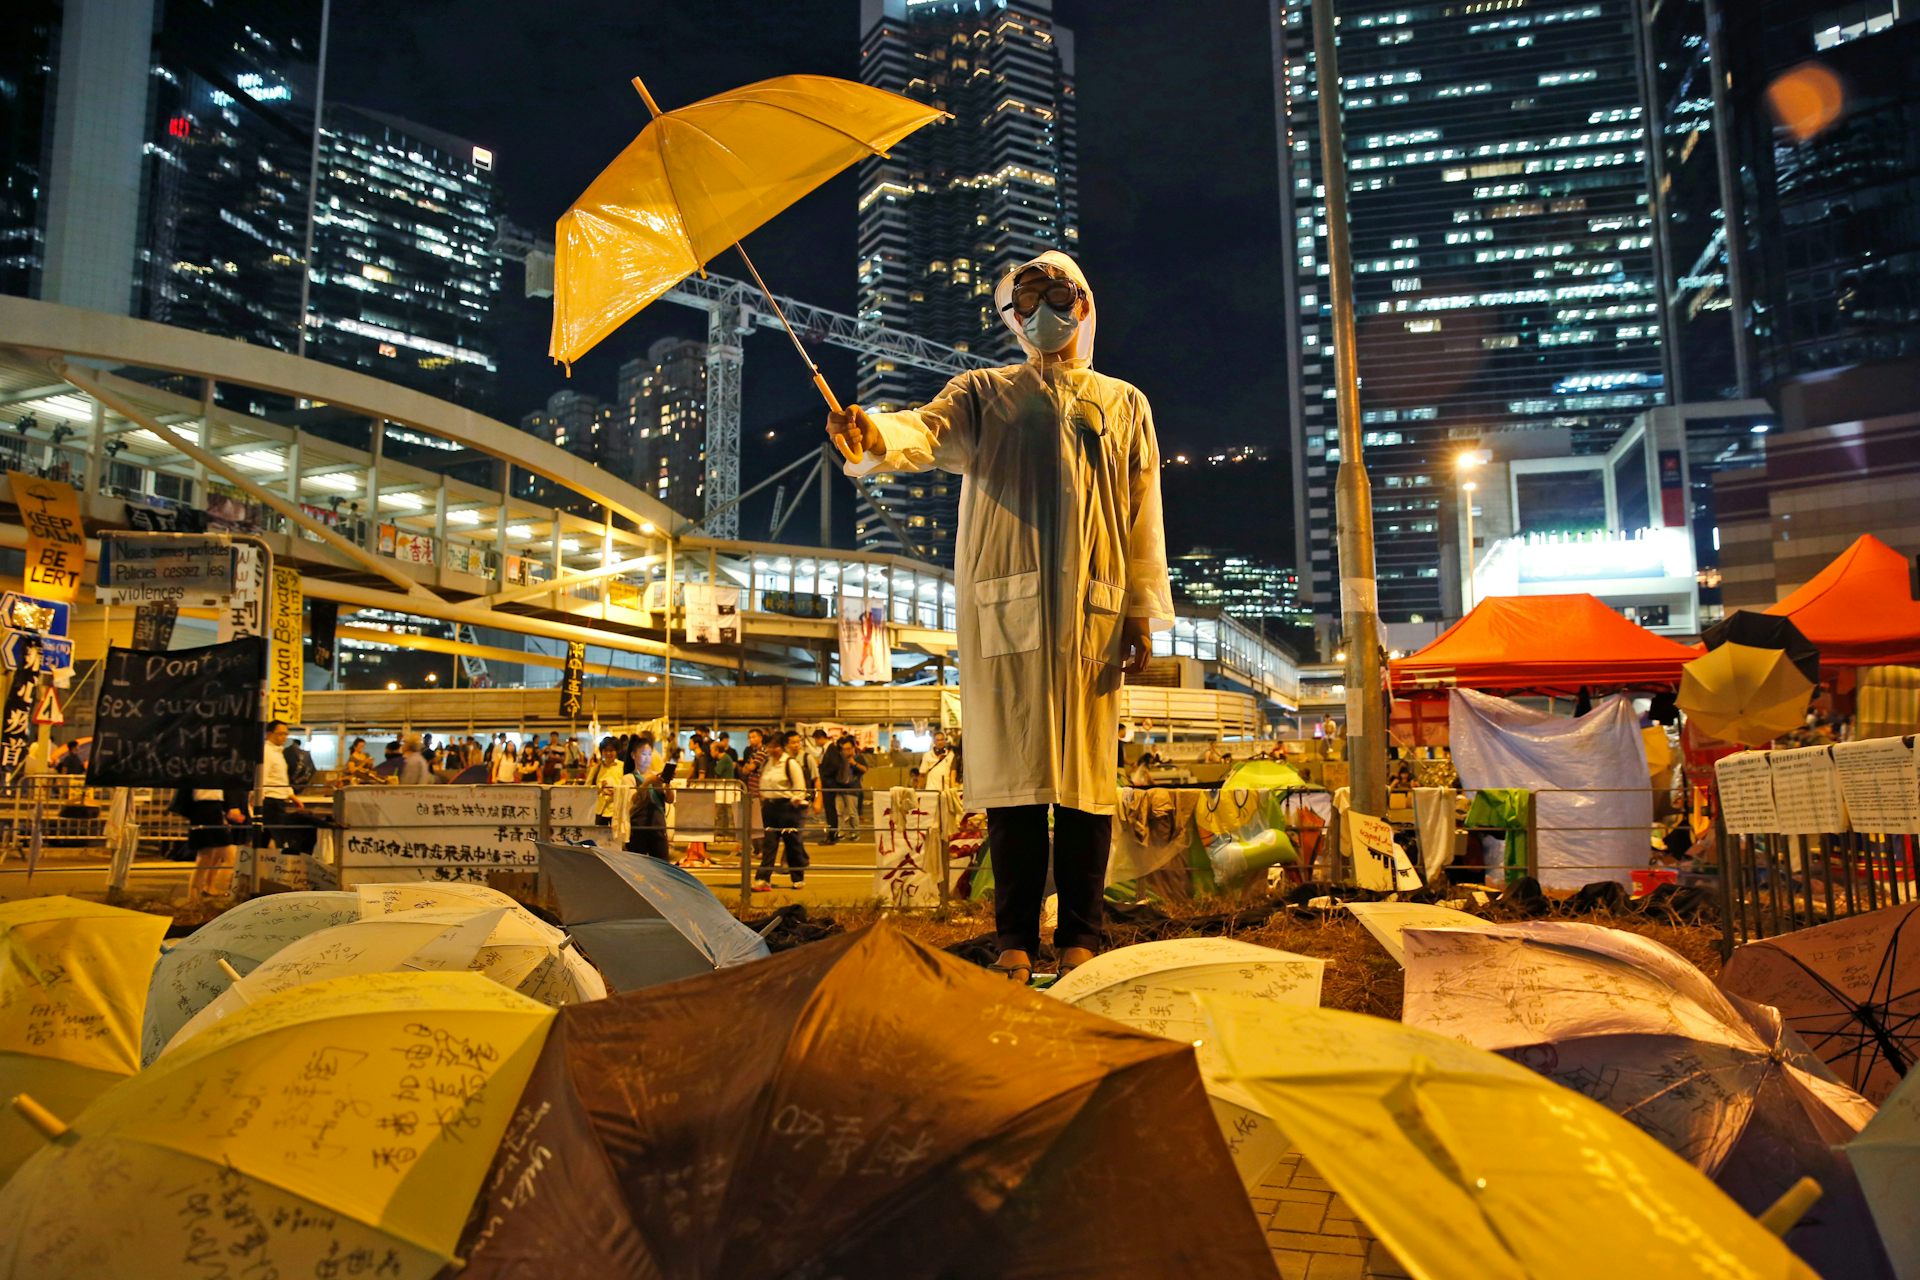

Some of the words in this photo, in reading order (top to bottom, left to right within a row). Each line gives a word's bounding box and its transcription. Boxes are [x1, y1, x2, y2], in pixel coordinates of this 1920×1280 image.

[25, 510, 73, 530] KEEP
[31, 525, 82, 546] CALM
[39, 548, 68, 568] BE
[206, 559, 225, 577] les
[118, 584, 186, 602] violences
[273, 566, 291, 646] Beware!
[271, 648, 291, 721] Taiwan
[179, 724, 231, 749] ME
